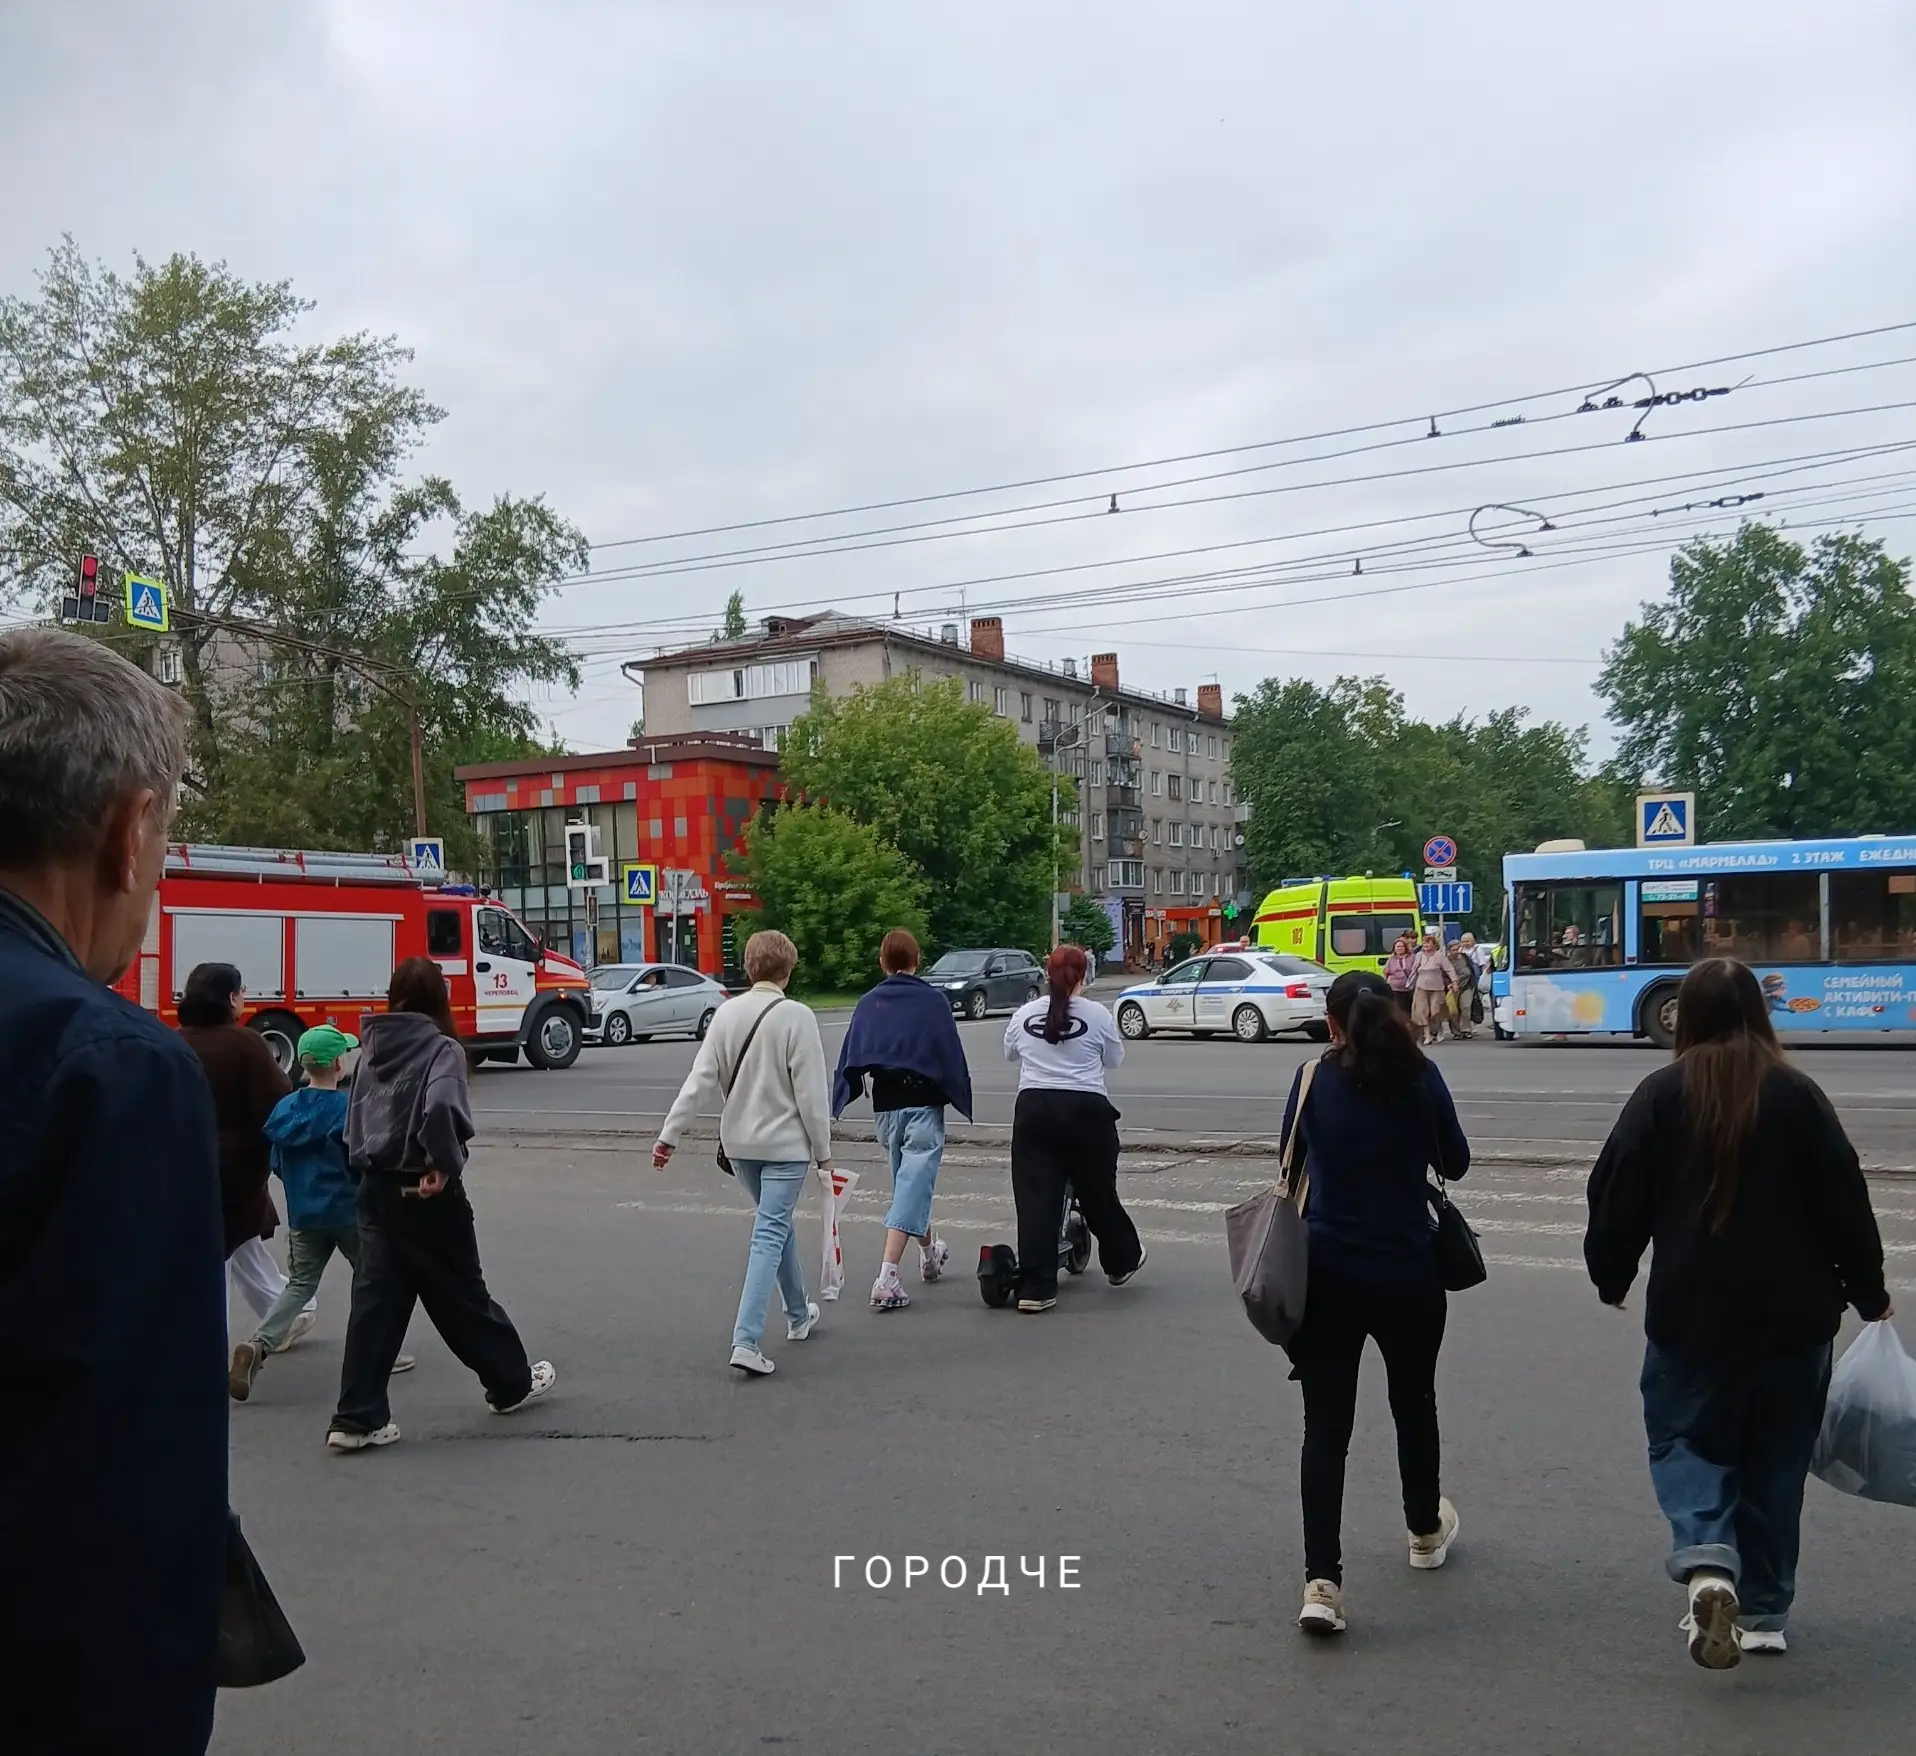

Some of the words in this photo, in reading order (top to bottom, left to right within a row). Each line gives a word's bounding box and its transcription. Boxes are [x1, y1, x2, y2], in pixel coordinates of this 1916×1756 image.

[1648, 859, 1674, 870] ТРЦ
[1679, 855, 1778, 867] «МАРМЕЛАД»
[1792, 853, 1800, 864] 2
[1804, 851, 1845, 863] ЭТАЖ
[494, 973, 508, 988] 13
[1824, 973, 1904, 988] СЕМЕЙНЫЙ
[1824, 1006, 1832, 1017] С
